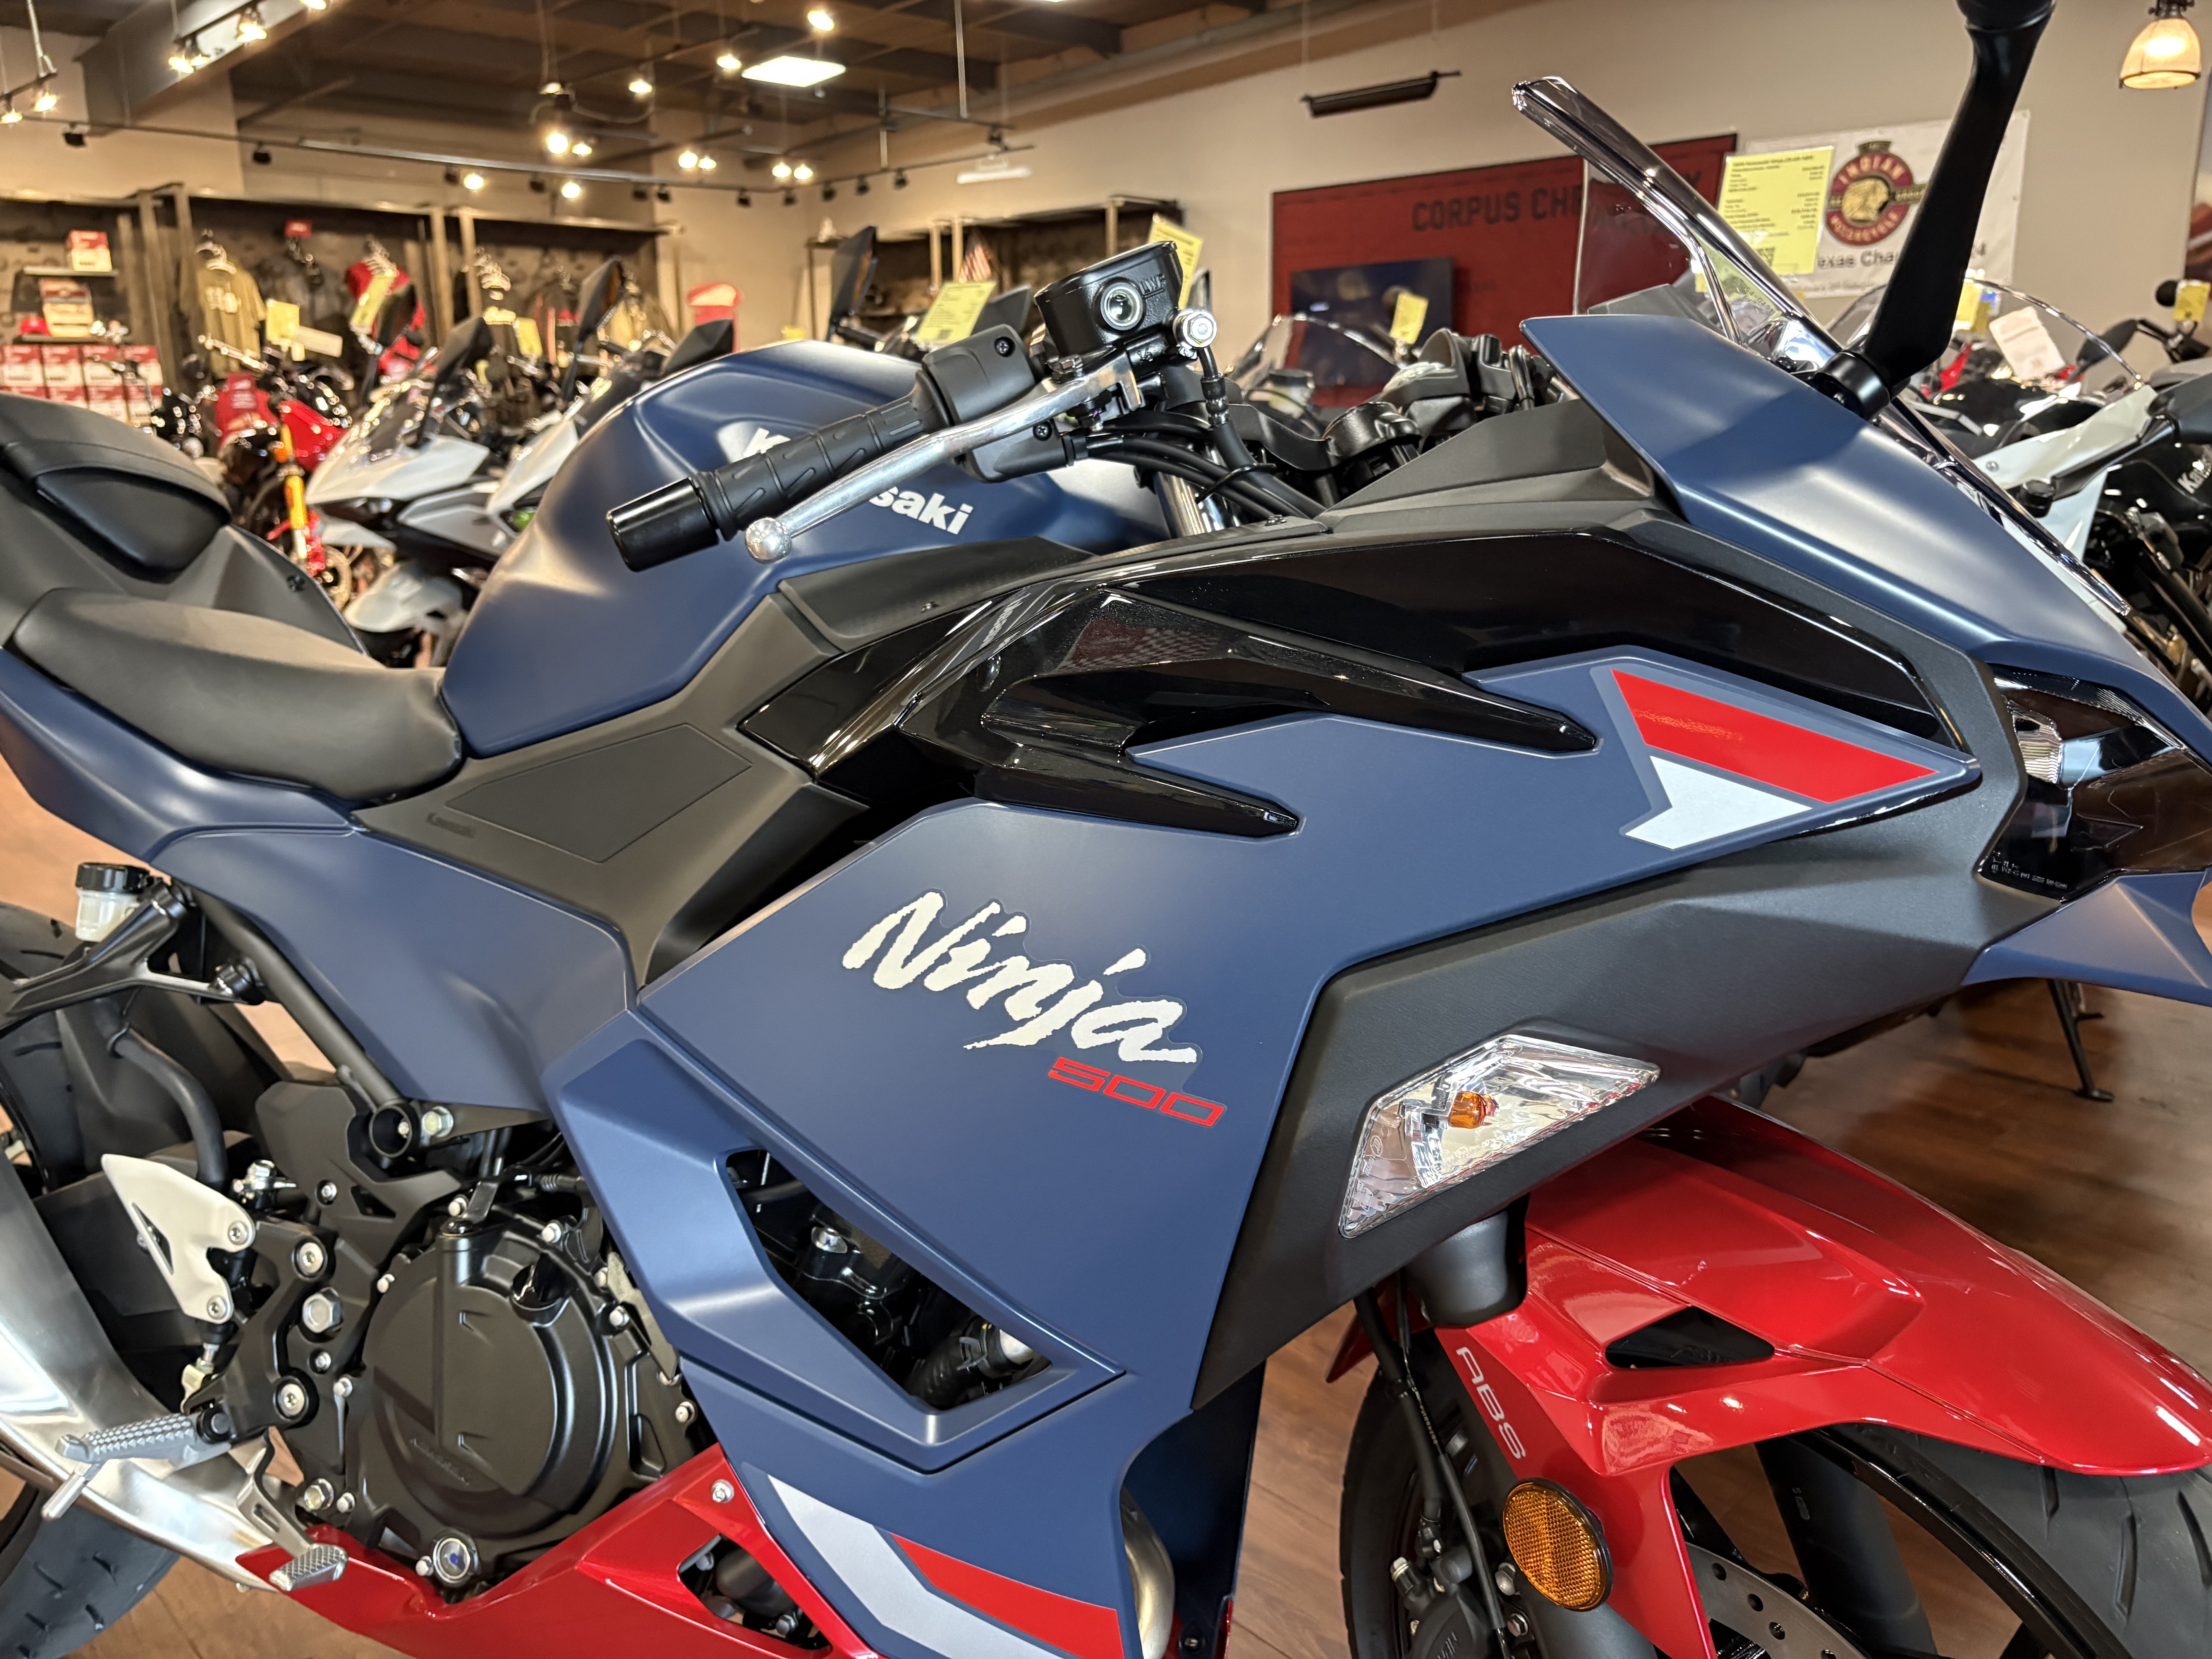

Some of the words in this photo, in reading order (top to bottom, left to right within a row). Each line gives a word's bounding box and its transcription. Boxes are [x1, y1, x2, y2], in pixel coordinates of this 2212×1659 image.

[1838, 155, 1906, 185] INDIAN
[1412, 191, 1520, 231] CORPUS
[1817, 254, 1855, 268] exas
[1860, 250, 1897, 267] Cha
[842, 892, 1197, 1063] Ninja
[1048, 1056, 1224, 1126] 500
[1456, 1346, 1526, 1459] ABS
